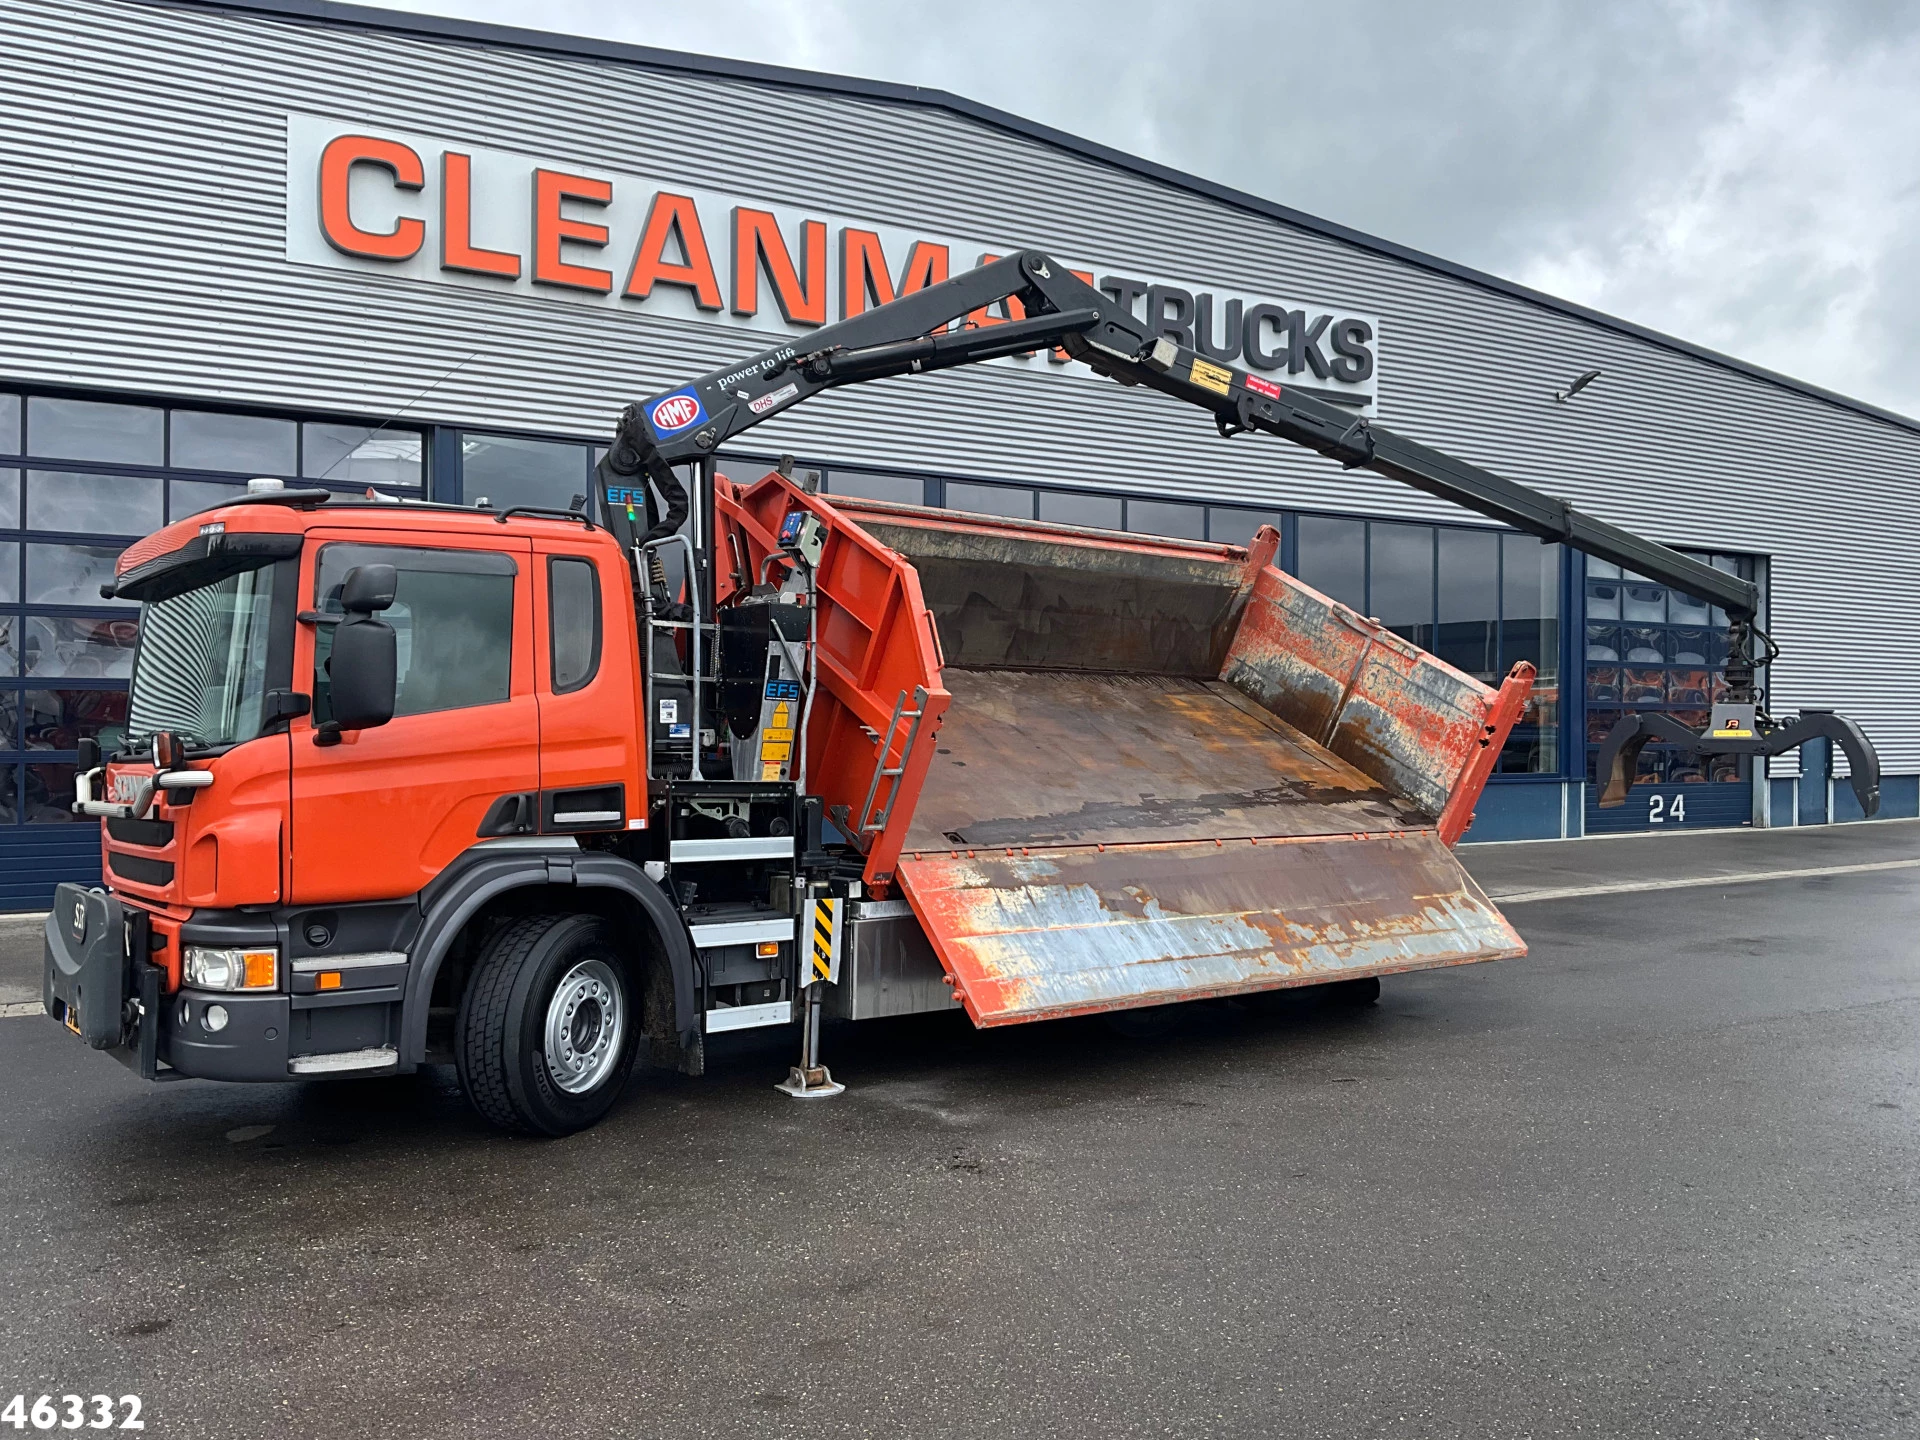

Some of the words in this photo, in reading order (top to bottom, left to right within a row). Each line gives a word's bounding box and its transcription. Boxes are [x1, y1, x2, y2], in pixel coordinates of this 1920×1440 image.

[1100, 275, 1374, 384] TRUCKS
[717, 364, 759, 391] power
[761, 358, 775, 370] to
[775, 347, 796, 361] lift
[657, 399, 692, 426] HMF
[753, 396, 773, 412] DHS
[607, 489, 644, 503] EFS
[766, 683, 798, 697] EFS
[1649, 794, 1686, 823] 24
